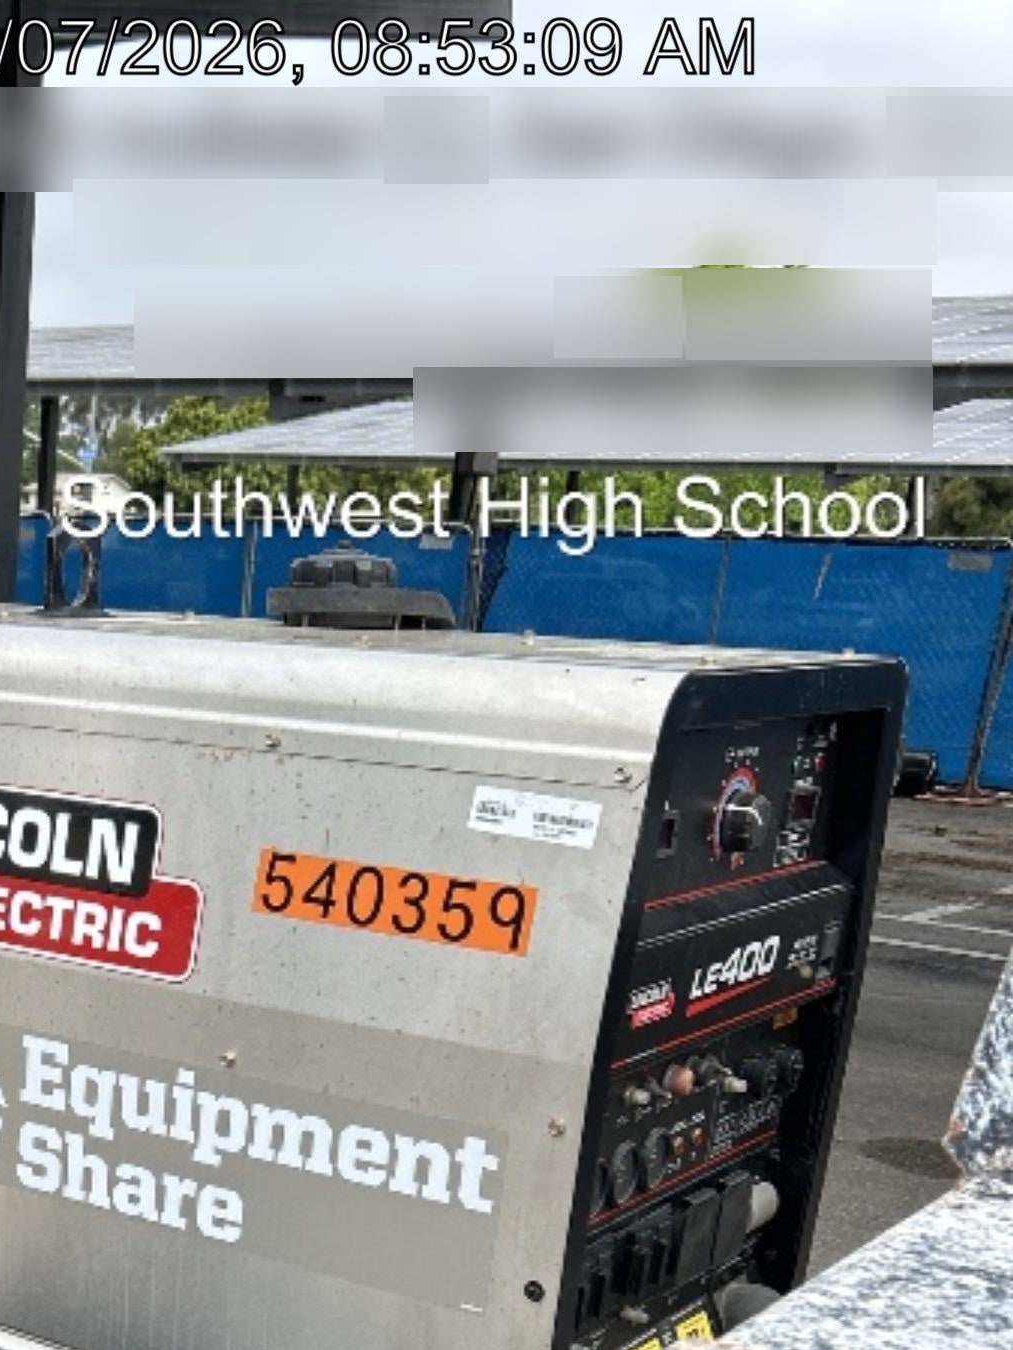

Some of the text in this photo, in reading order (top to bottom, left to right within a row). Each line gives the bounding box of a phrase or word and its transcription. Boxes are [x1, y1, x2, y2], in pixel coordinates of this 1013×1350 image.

[260, 851, 525, 950] 540359
[689, 935, 781, 1000] LE400
[19, 1033, 500, 1215] Equipment
[15, 1121, 245, 1244] Share
